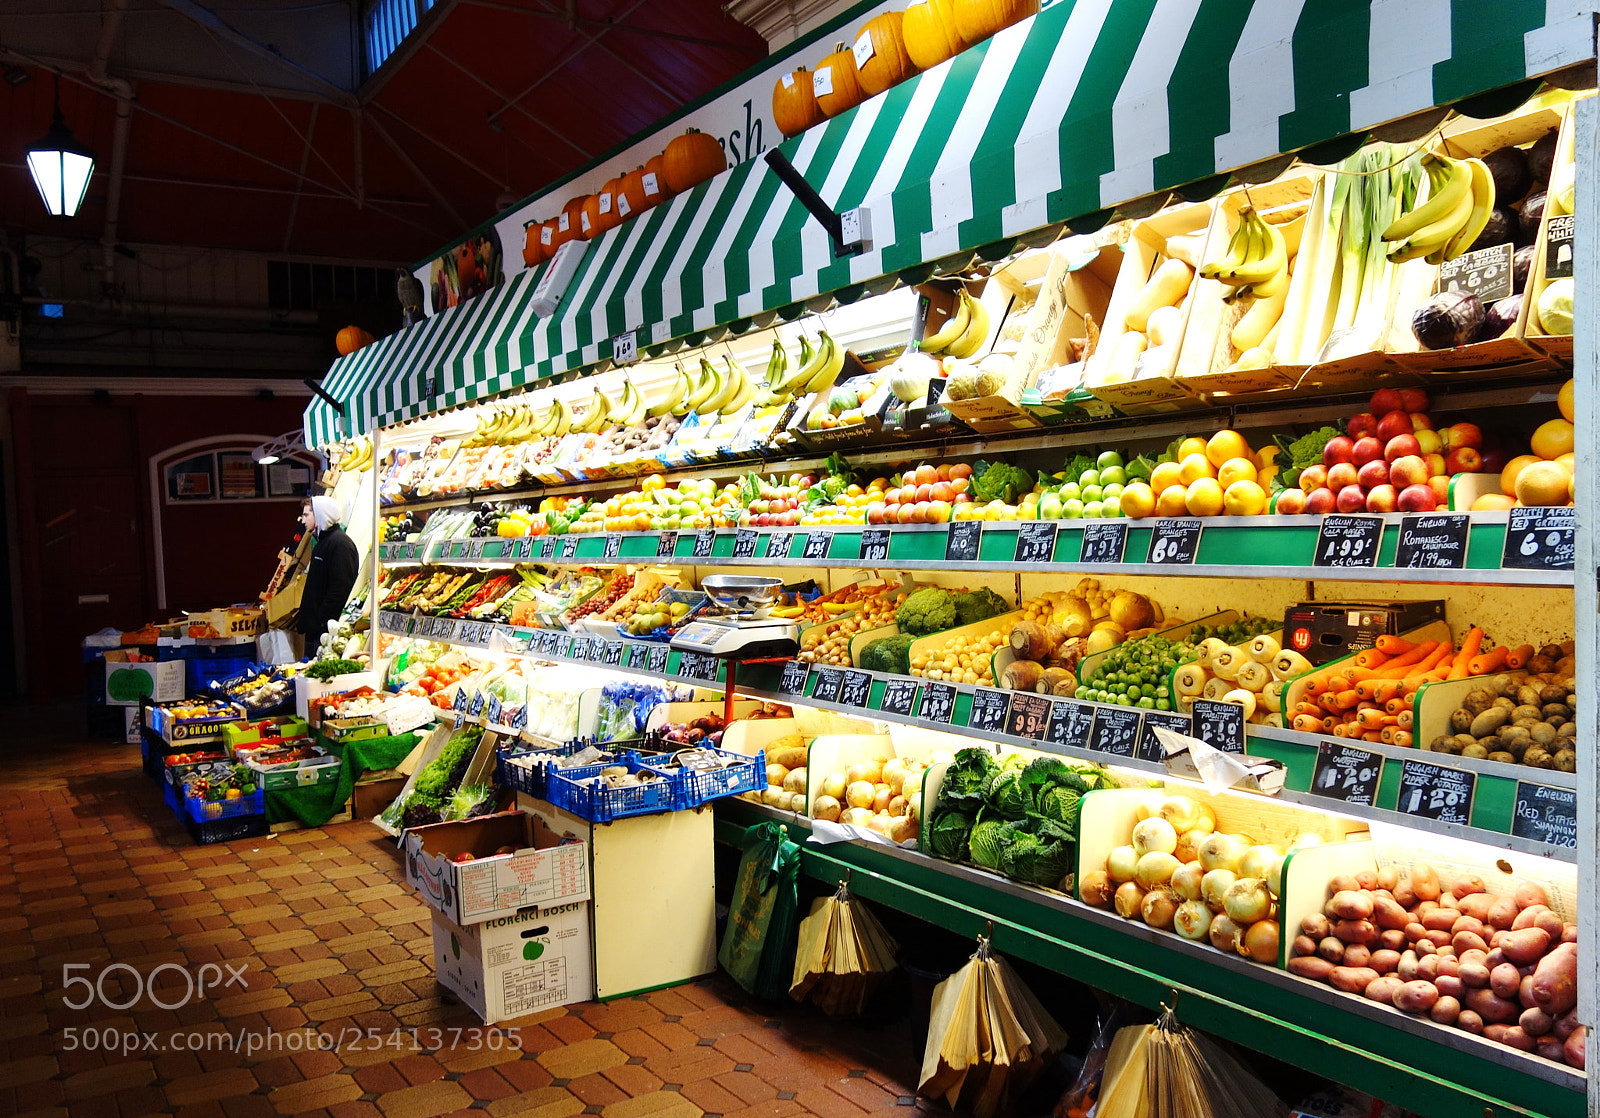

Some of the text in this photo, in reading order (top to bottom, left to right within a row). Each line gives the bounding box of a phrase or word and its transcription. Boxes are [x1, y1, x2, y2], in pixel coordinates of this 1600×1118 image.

[1511, 508, 1544, 516] SOUTH
[1324, 518, 1377, 527] ENGLISH ROYAL
[1416, 516, 1447, 528] ENGLISH
[1511, 519, 1529, 528] RED
[1151, 537, 1178, 563] 60
[1098, 728, 1131, 748] 2.20
[1201, 720, 1237, 742] 2.50
[1341, 747, 1371, 760] ENGLISH
[1404, 762, 1440, 775] ENGLISH
[1324, 767, 1372, 789] 1.20
[1407, 788, 1459, 814] 1.20
[1535, 786, 1575, 803] ENGLISH
[1516, 799, 1539, 820] RED
[486, 902, 579, 930] FLORENCI BOSCH
